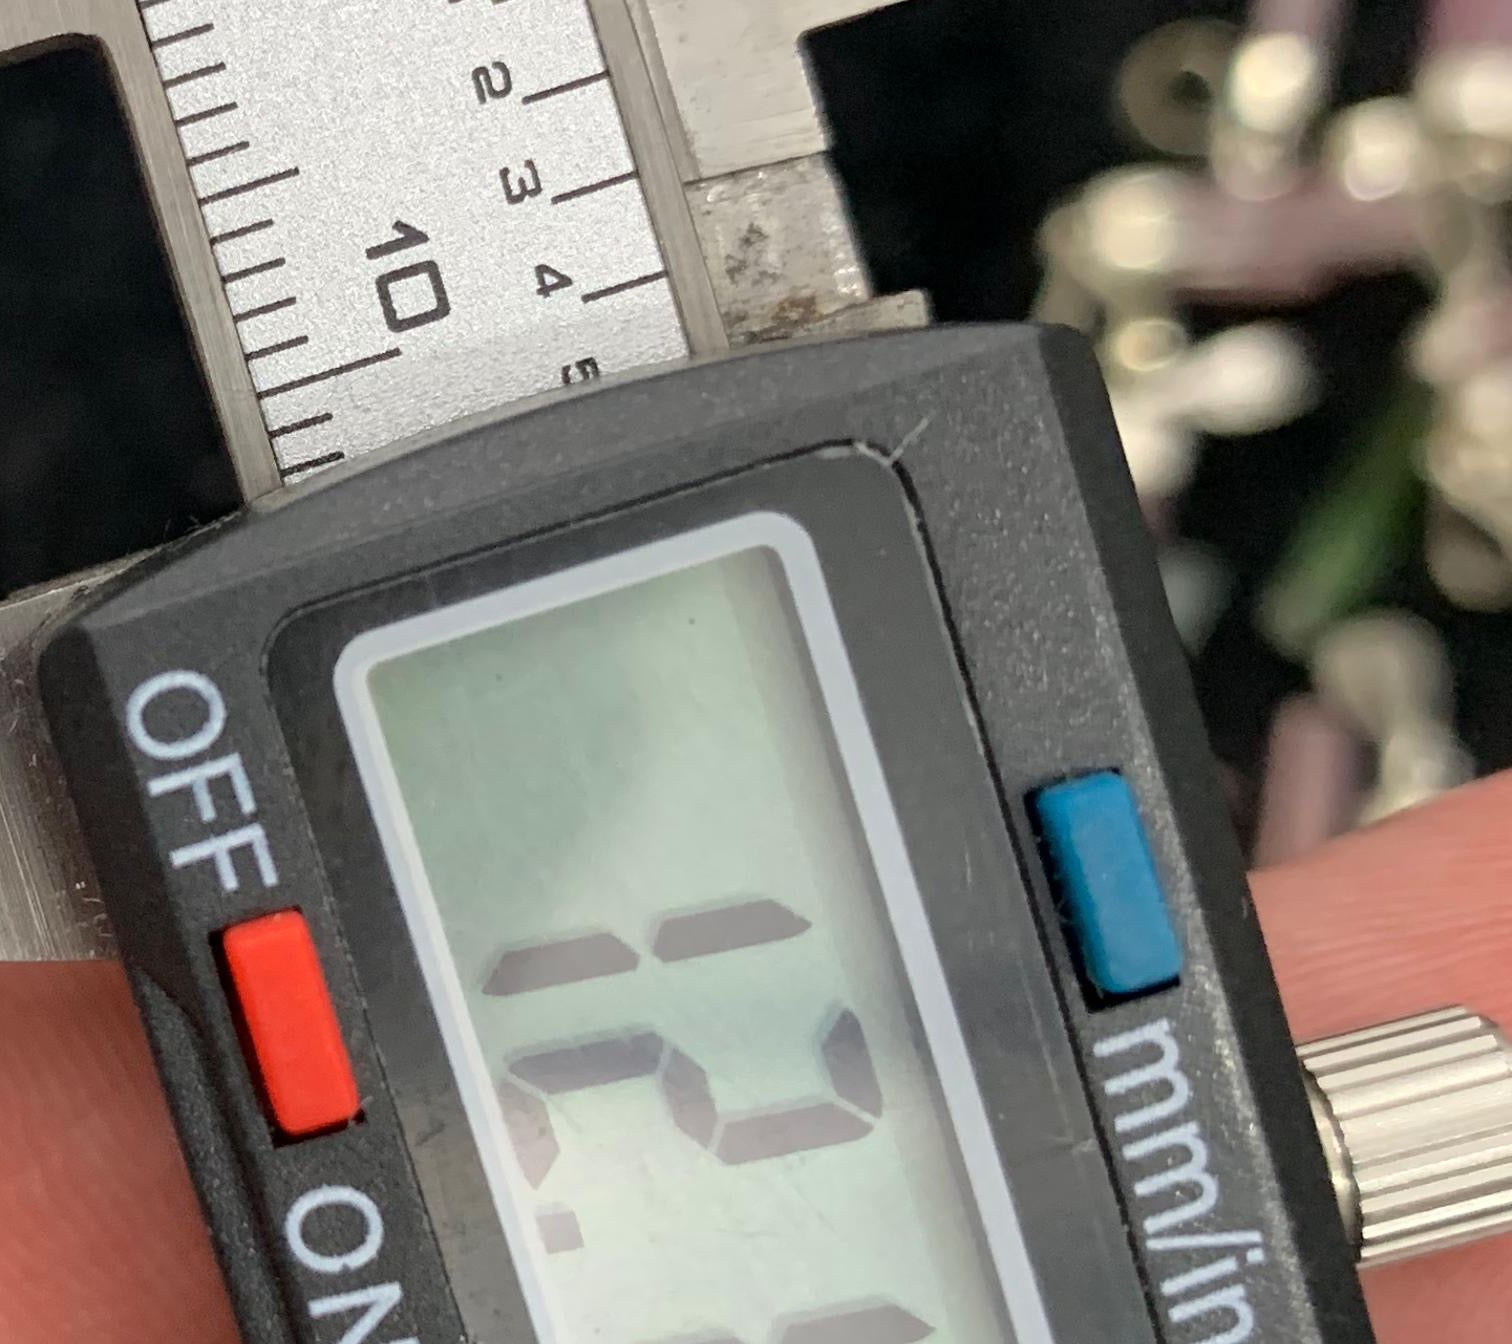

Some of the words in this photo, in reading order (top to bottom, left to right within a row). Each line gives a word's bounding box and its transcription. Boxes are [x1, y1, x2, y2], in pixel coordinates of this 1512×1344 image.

[472, 60, 513, 105] 2
[499, 158, 543, 205] 3
[364, 220, 451, 333] 10
[534, 263, 574, 299] 4
[127, 670, 279, 892] OFF
